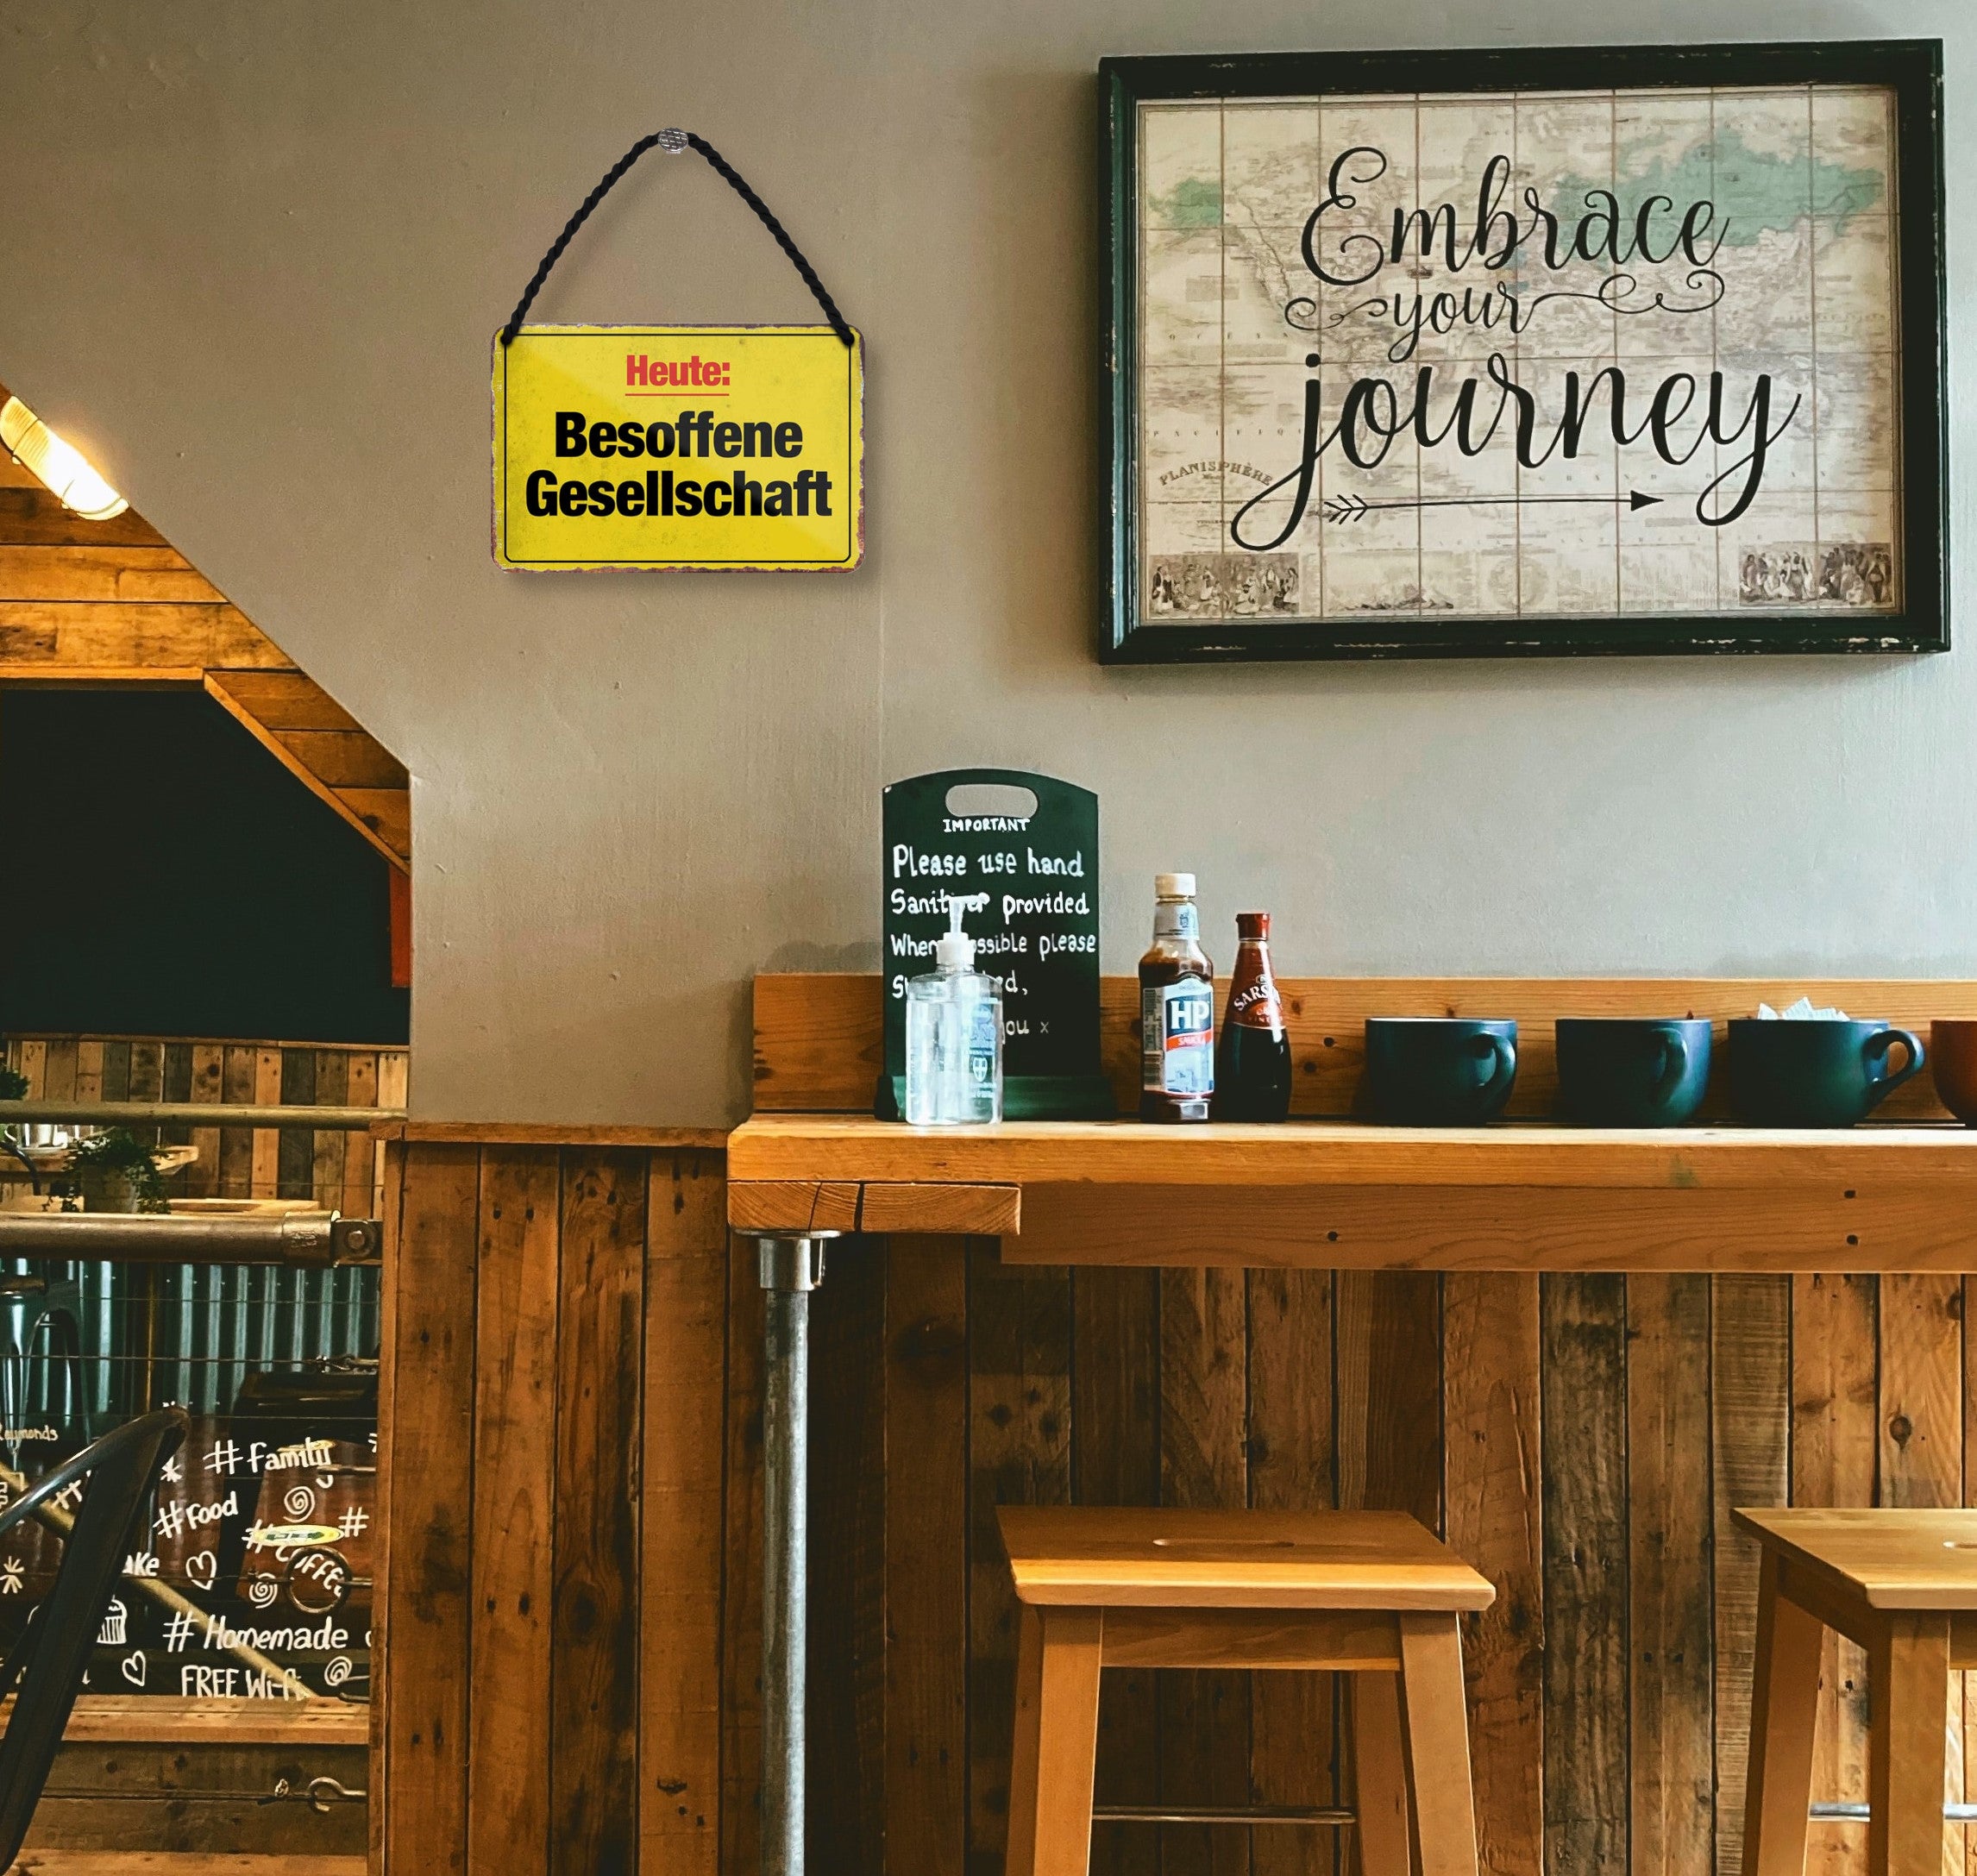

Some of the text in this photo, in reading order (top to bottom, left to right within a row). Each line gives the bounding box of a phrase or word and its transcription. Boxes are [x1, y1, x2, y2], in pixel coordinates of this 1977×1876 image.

[1302, 147, 1729, 286] Embrace
[626, 354, 731, 386] Heute:
[555, 411, 803, 458] Besoffene
[1231, 353, 1801, 550] journey
[1159, 461, 1273, 486] PLANISPHÈRE
[526, 469, 832, 518] Gesellschaft
[943, 818, 1030, 832] IMPORTANT
[893, 844, 1084, 878] Please use hand
[1002, 891, 1090, 925] provided
[971, 932, 1027, 954] ssible
[1039, 934, 1096, 962] please
[1002, 1020, 1030, 1041] ou
[1170, 1000, 1210, 1030] HP
[181, 1665, 239, 1698] FREE
